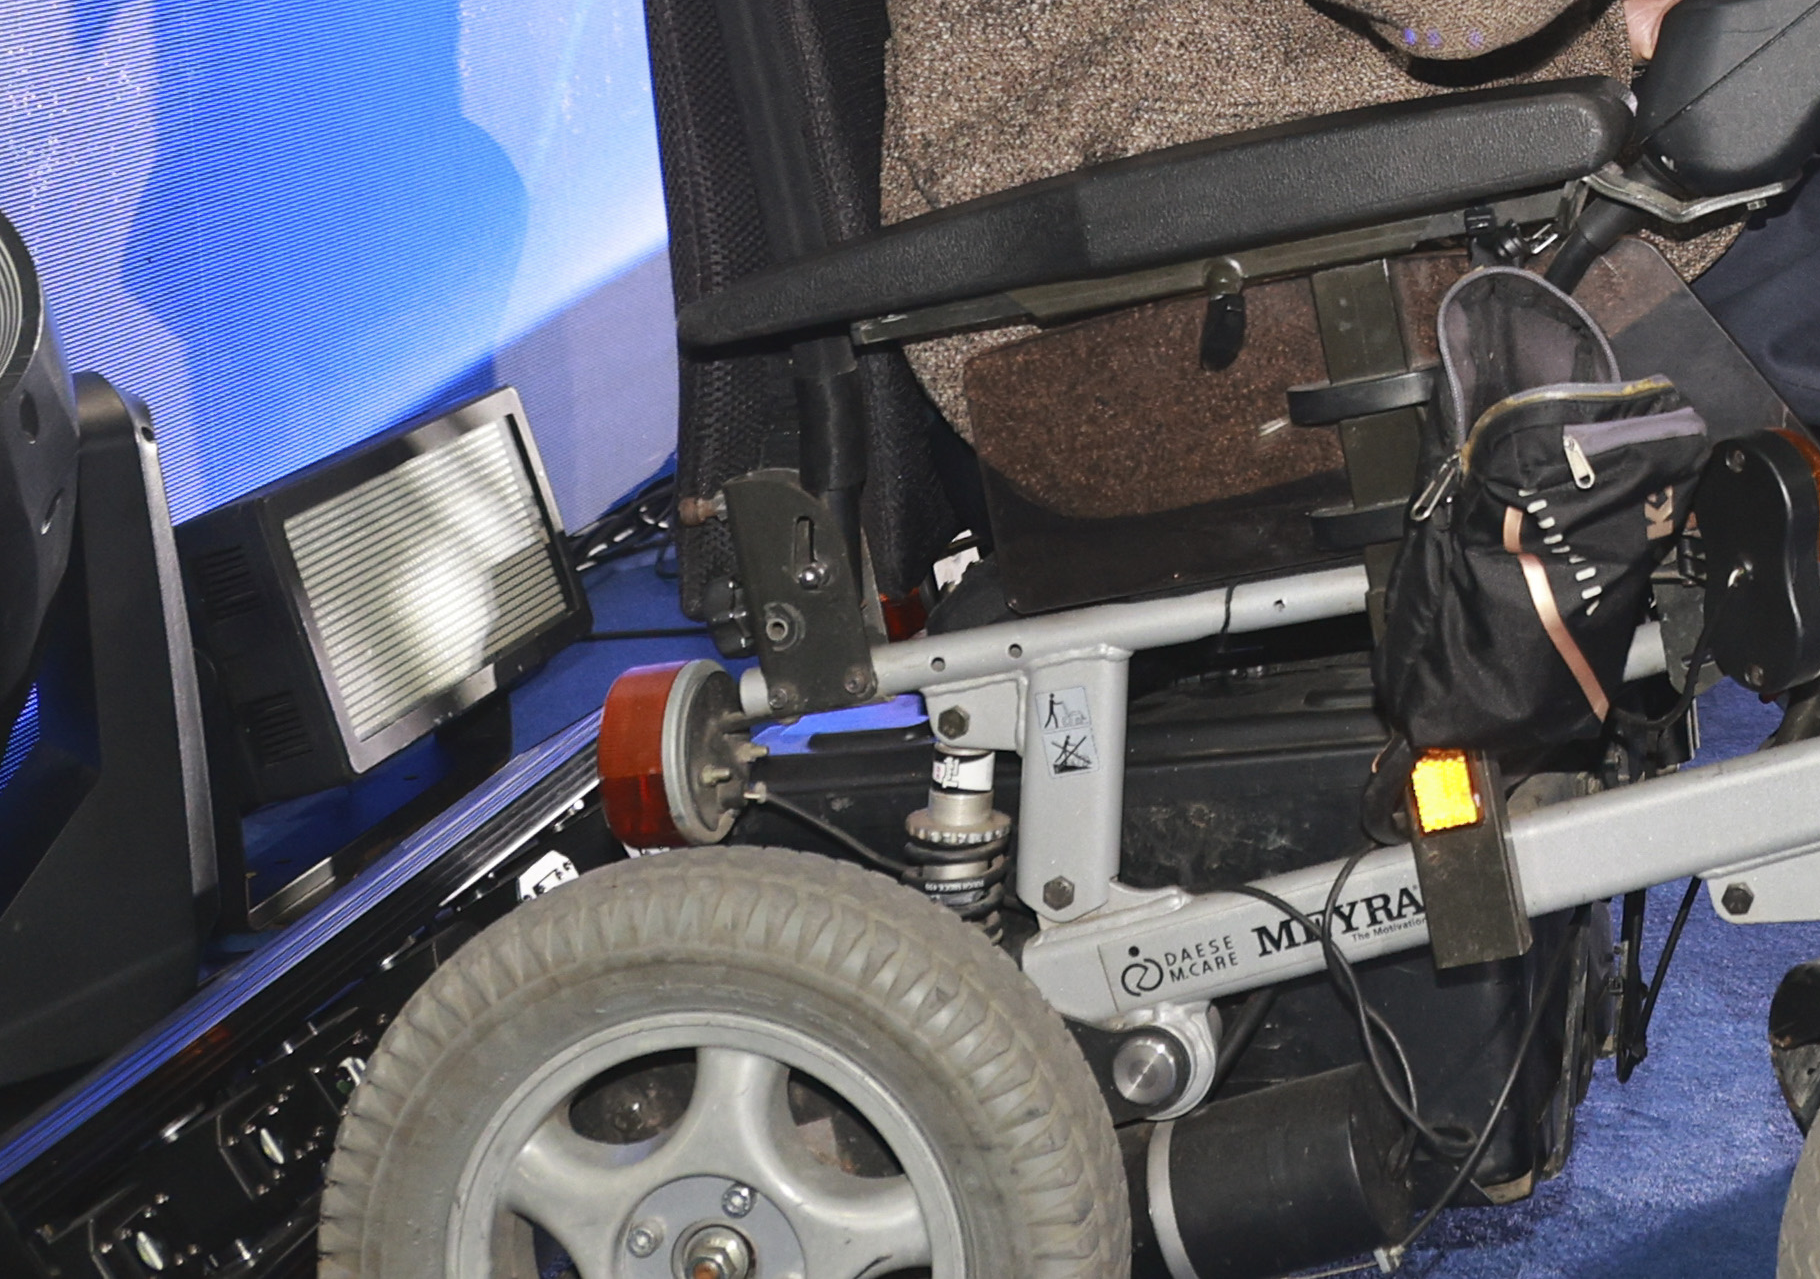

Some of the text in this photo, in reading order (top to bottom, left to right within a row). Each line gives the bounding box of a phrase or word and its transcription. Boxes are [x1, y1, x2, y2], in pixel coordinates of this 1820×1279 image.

[1165, 935, 1235, 967] DAESE
[1352, 932, 1371, 943] The
[1169, 954, 1240, 984] M.CARE
